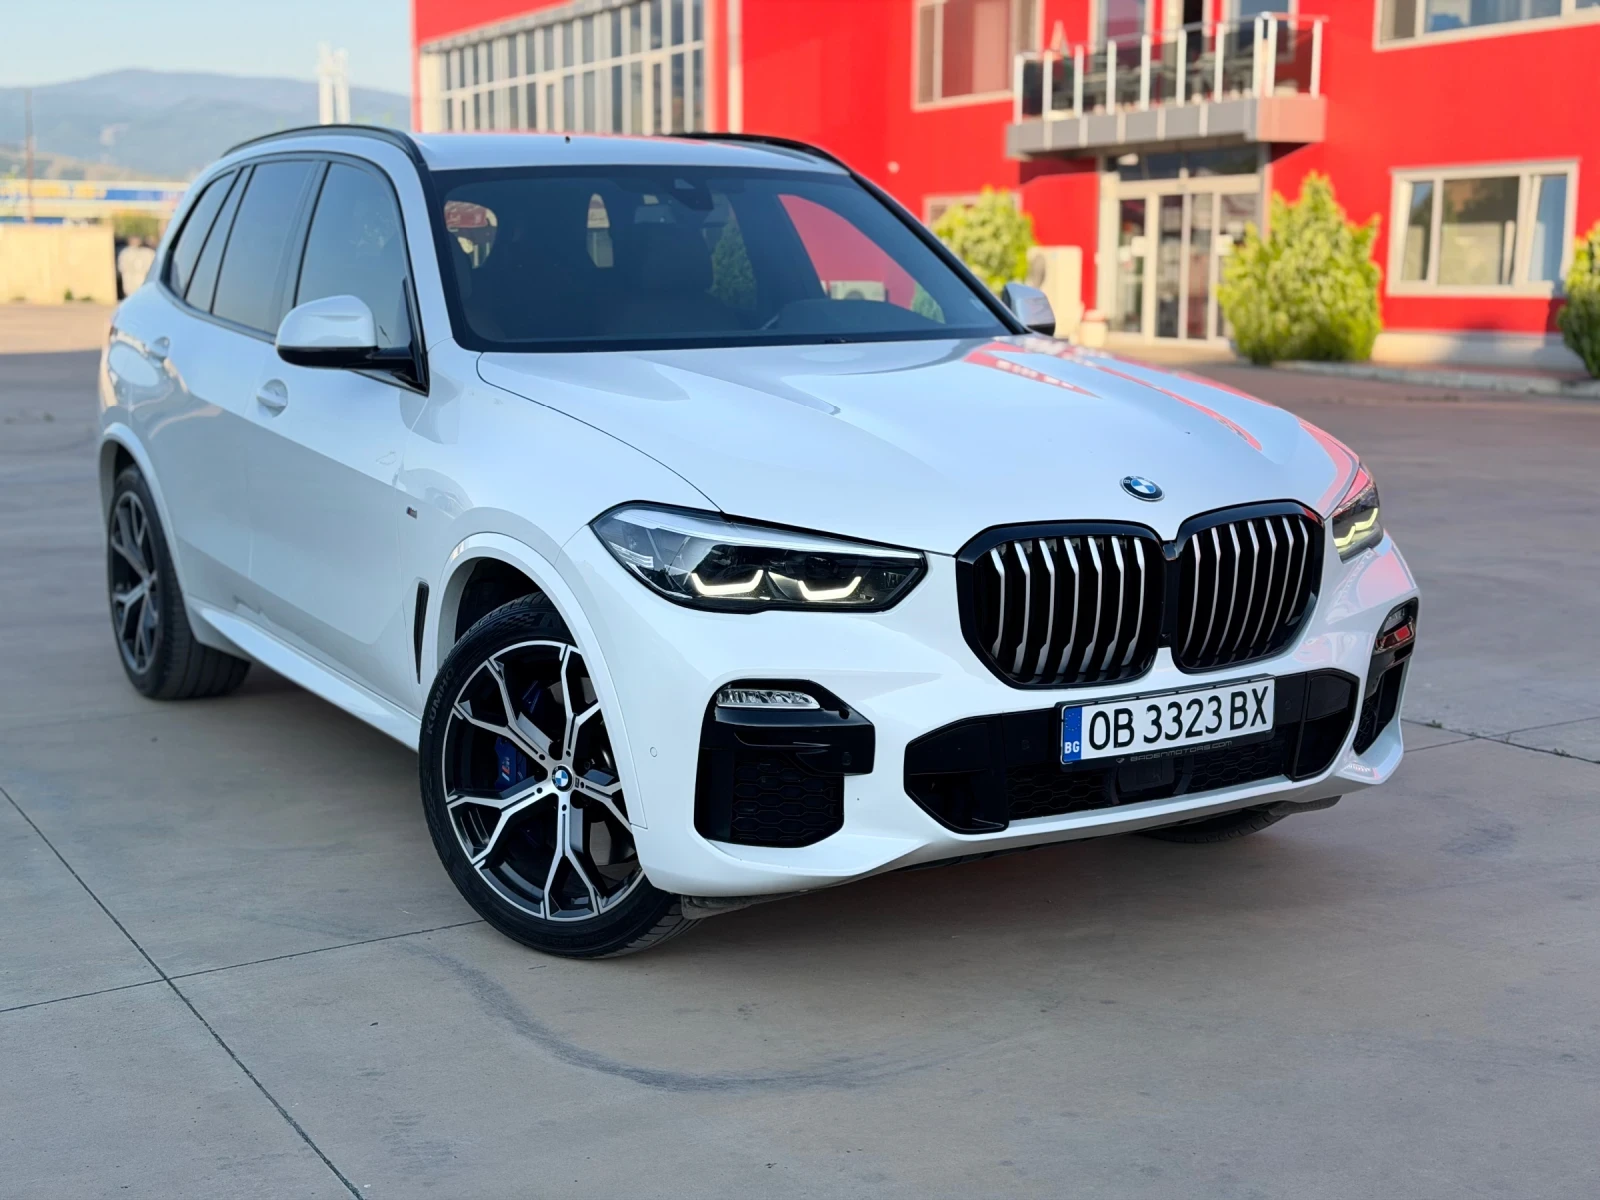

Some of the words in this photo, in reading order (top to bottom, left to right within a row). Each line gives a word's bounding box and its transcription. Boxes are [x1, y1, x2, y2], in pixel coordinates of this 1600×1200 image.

[426, 667, 455, 735] KUMHO
[1088, 707, 1135, 750] OB
[1143, 695, 1223, 744] 3323
[1229, 686, 1269, 731] BX
[1064, 740, 1080, 754] BG
